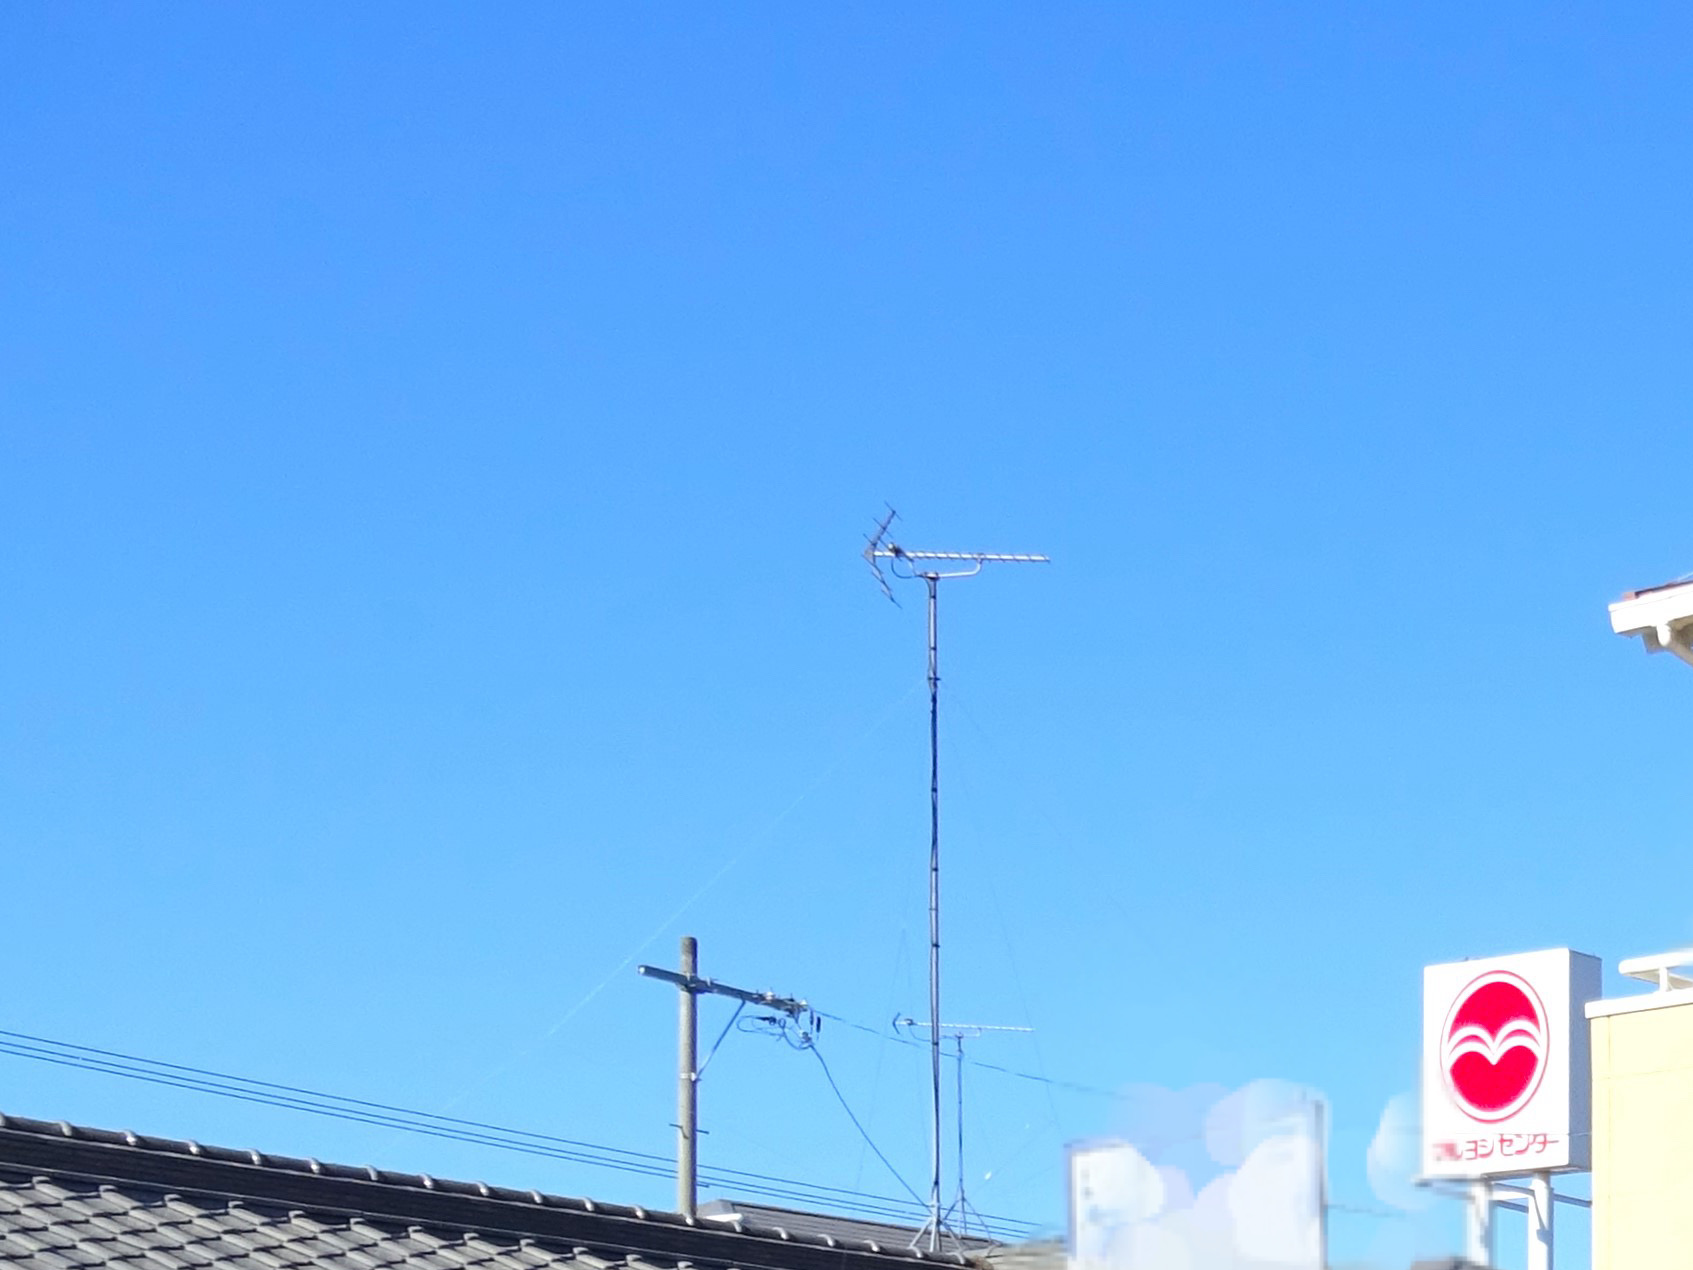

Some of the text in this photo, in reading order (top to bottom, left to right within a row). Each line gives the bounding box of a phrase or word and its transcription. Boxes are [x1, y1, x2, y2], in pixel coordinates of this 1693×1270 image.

[1433, 1133, 1559, 1161] ヨシセンター
